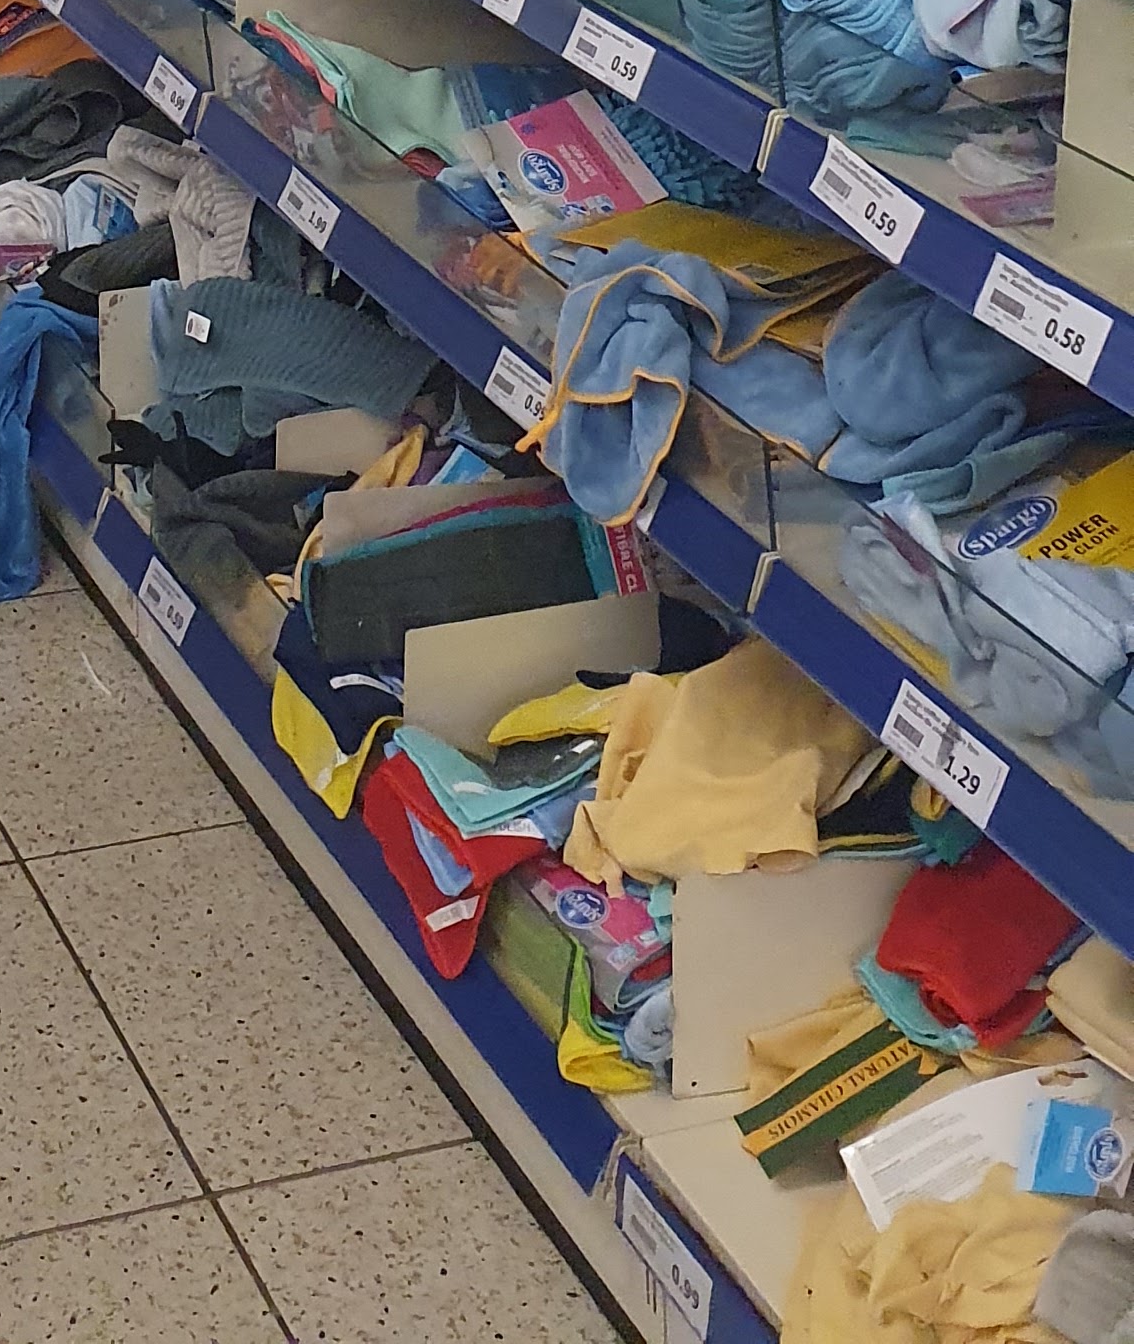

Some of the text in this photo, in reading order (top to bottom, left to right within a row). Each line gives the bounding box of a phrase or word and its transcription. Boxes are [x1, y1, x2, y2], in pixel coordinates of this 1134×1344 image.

[610, 55, 637, 81] 0.59
[527, 154, 560, 191] spargo
[308, 211, 327, 233] 1.99
[864, 202, 897, 236] 0.59
[1045, 318, 1085, 355] 0.58
[968, 502, 1046, 553] spargo
[1039, 514, 1108, 558] POWER
[1074, 524, 1119, 555] CLOTH
[944, 756, 981, 795] 1.29
[769, 1042, 913, 1140] ATURAL CHAMOIS
[672, 1265, 699, 1309] 0.99
